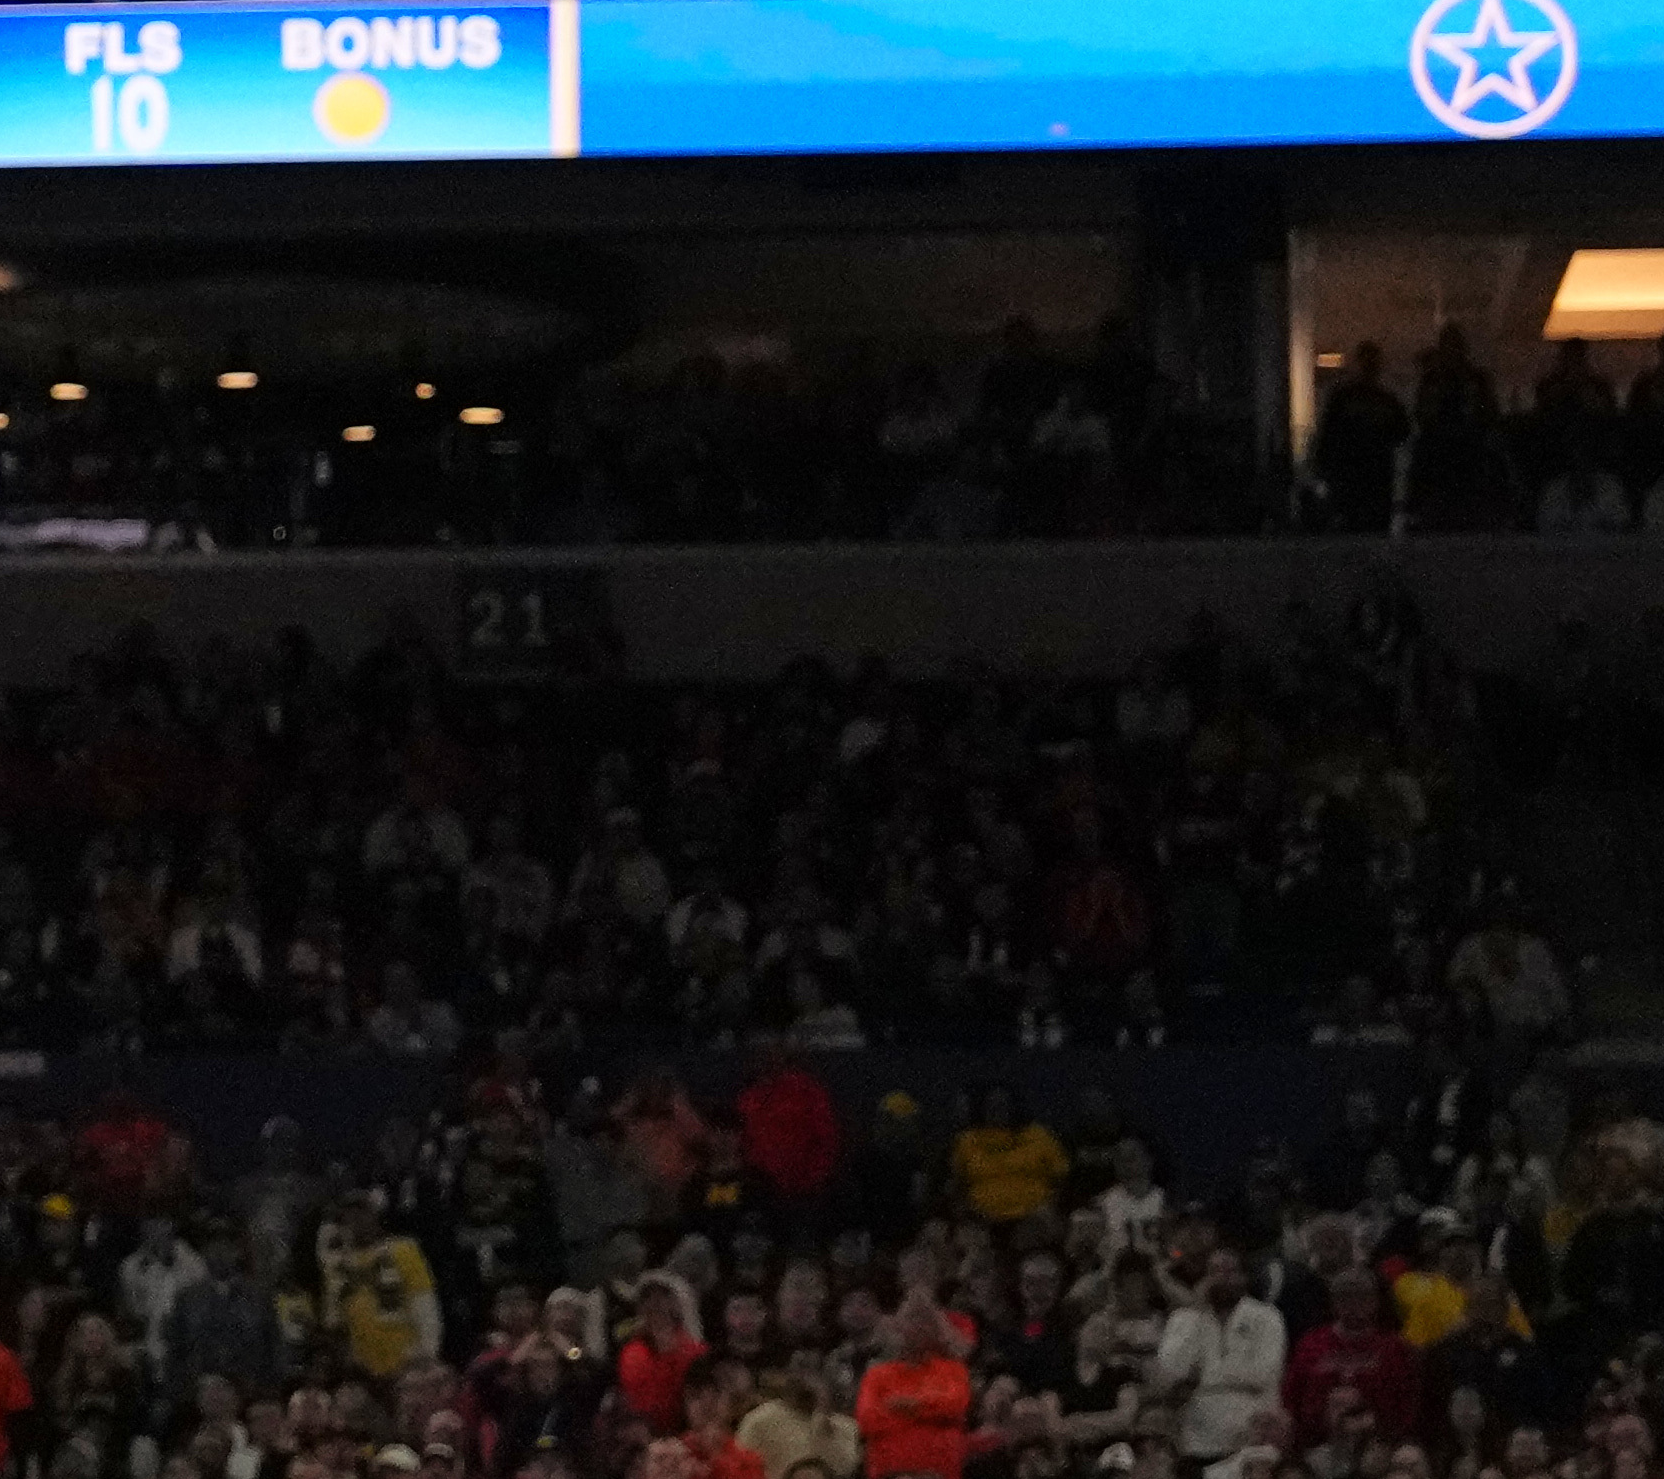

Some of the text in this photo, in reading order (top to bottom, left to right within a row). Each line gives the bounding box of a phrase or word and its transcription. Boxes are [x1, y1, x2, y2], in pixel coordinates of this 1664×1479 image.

[63, 20, 183, 76] FLS
[280, 14, 503, 72] BONUS
[89, 73, 171, 156] 10
